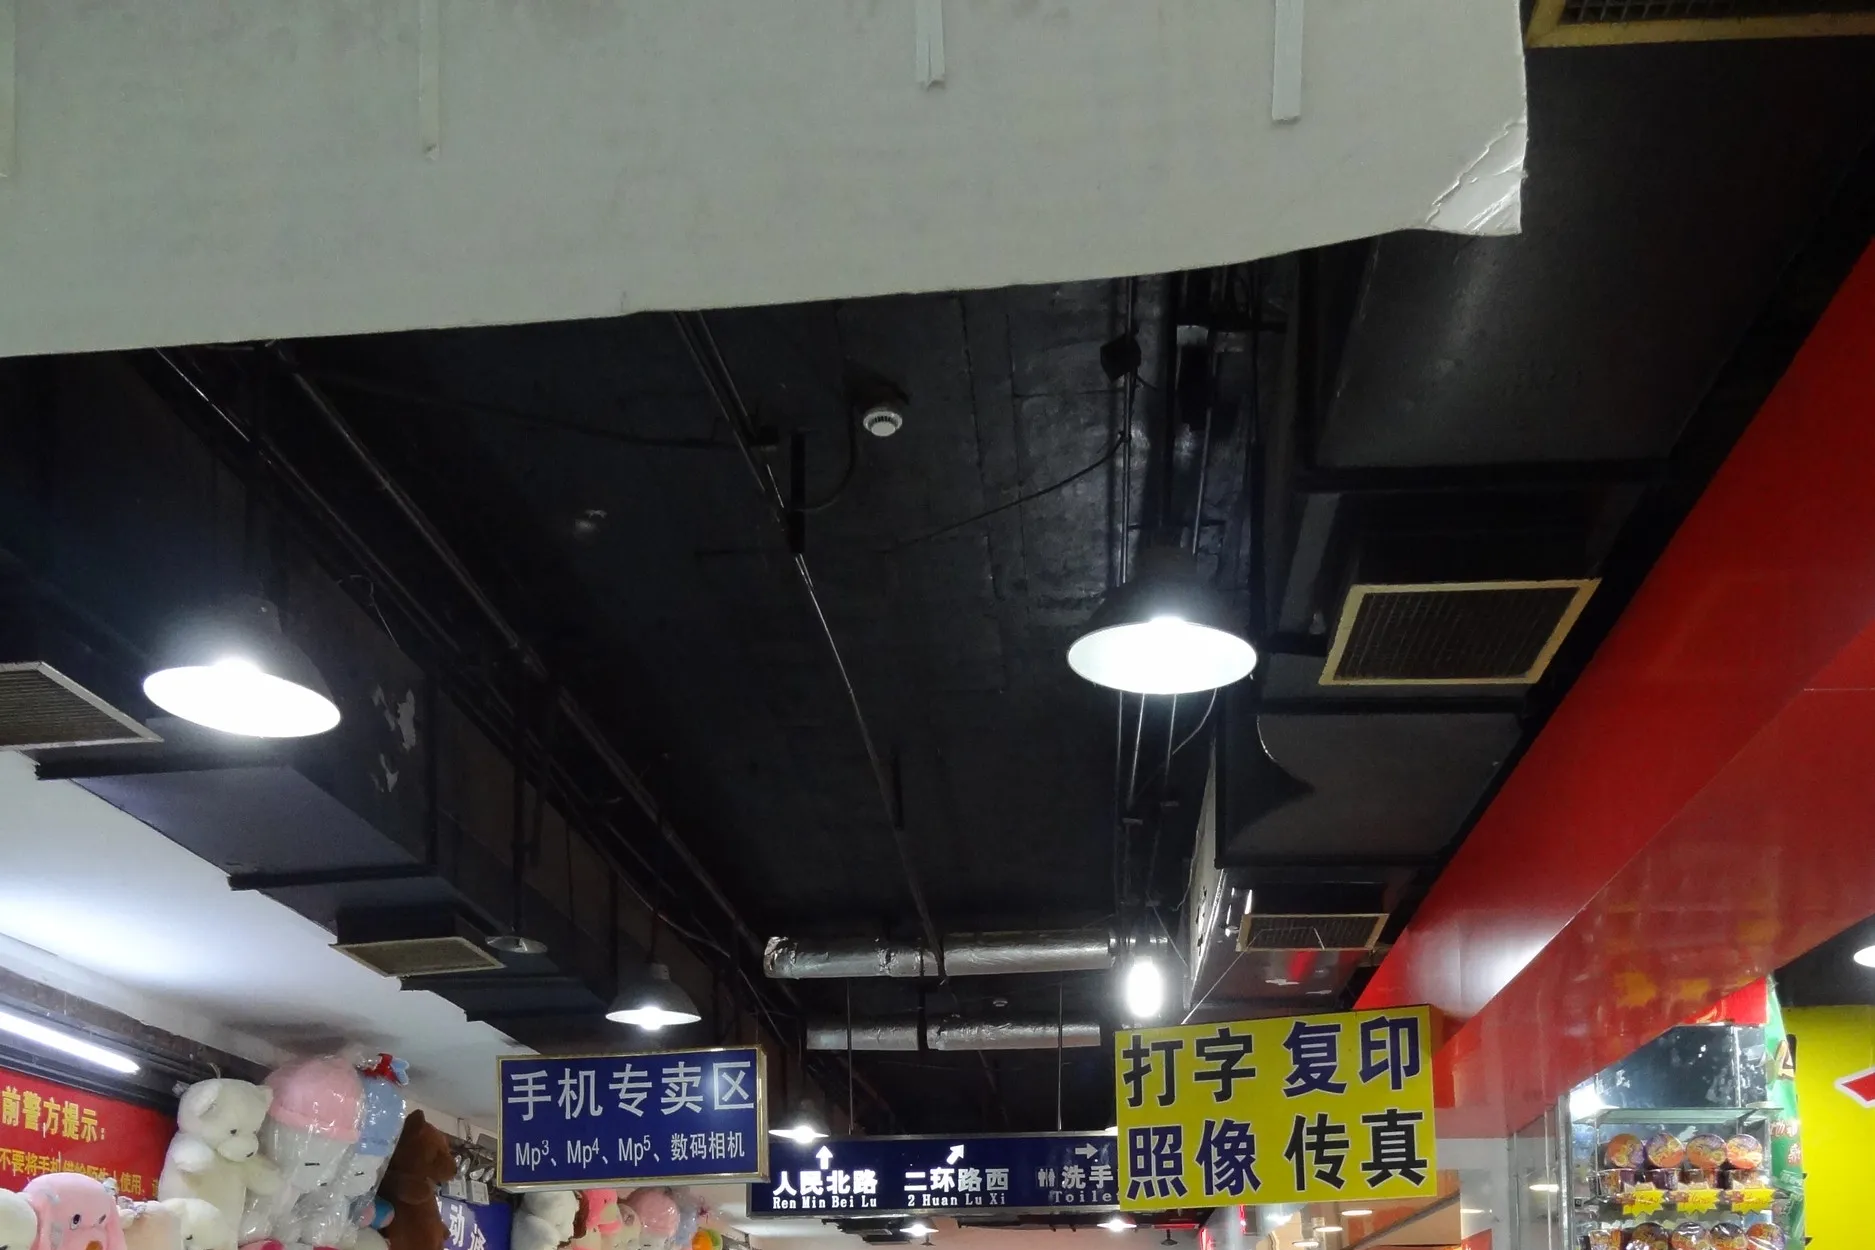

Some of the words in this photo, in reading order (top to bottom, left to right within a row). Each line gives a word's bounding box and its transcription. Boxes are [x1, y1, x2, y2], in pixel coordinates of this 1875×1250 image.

[1122, 1027, 1256, 1107] 打字
[1282, 1016, 1420, 1098] 复印
[508, 1061, 754, 1121] 手机专卖区
[1126, 1118, 1262, 1200] 照像
[1283, 1108, 1428, 1192] 传真
[772, 1170, 878, 1196] 人民北路
[904, 1167, 1009, 1192] 二环路西
[773, 1197, 797, 1209] Ren
[802, 1196, 826, 1208] Min
[831, 1195, 854, 1208] Bei
[861, 1195, 877, 1208] Lu
[907, 1194, 915, 1206] 2
[922, 1194, 958, 1206] Huan
[965, 1193, 982, 1205] Lu
[989, 1192, 1005, 1205] Xi
